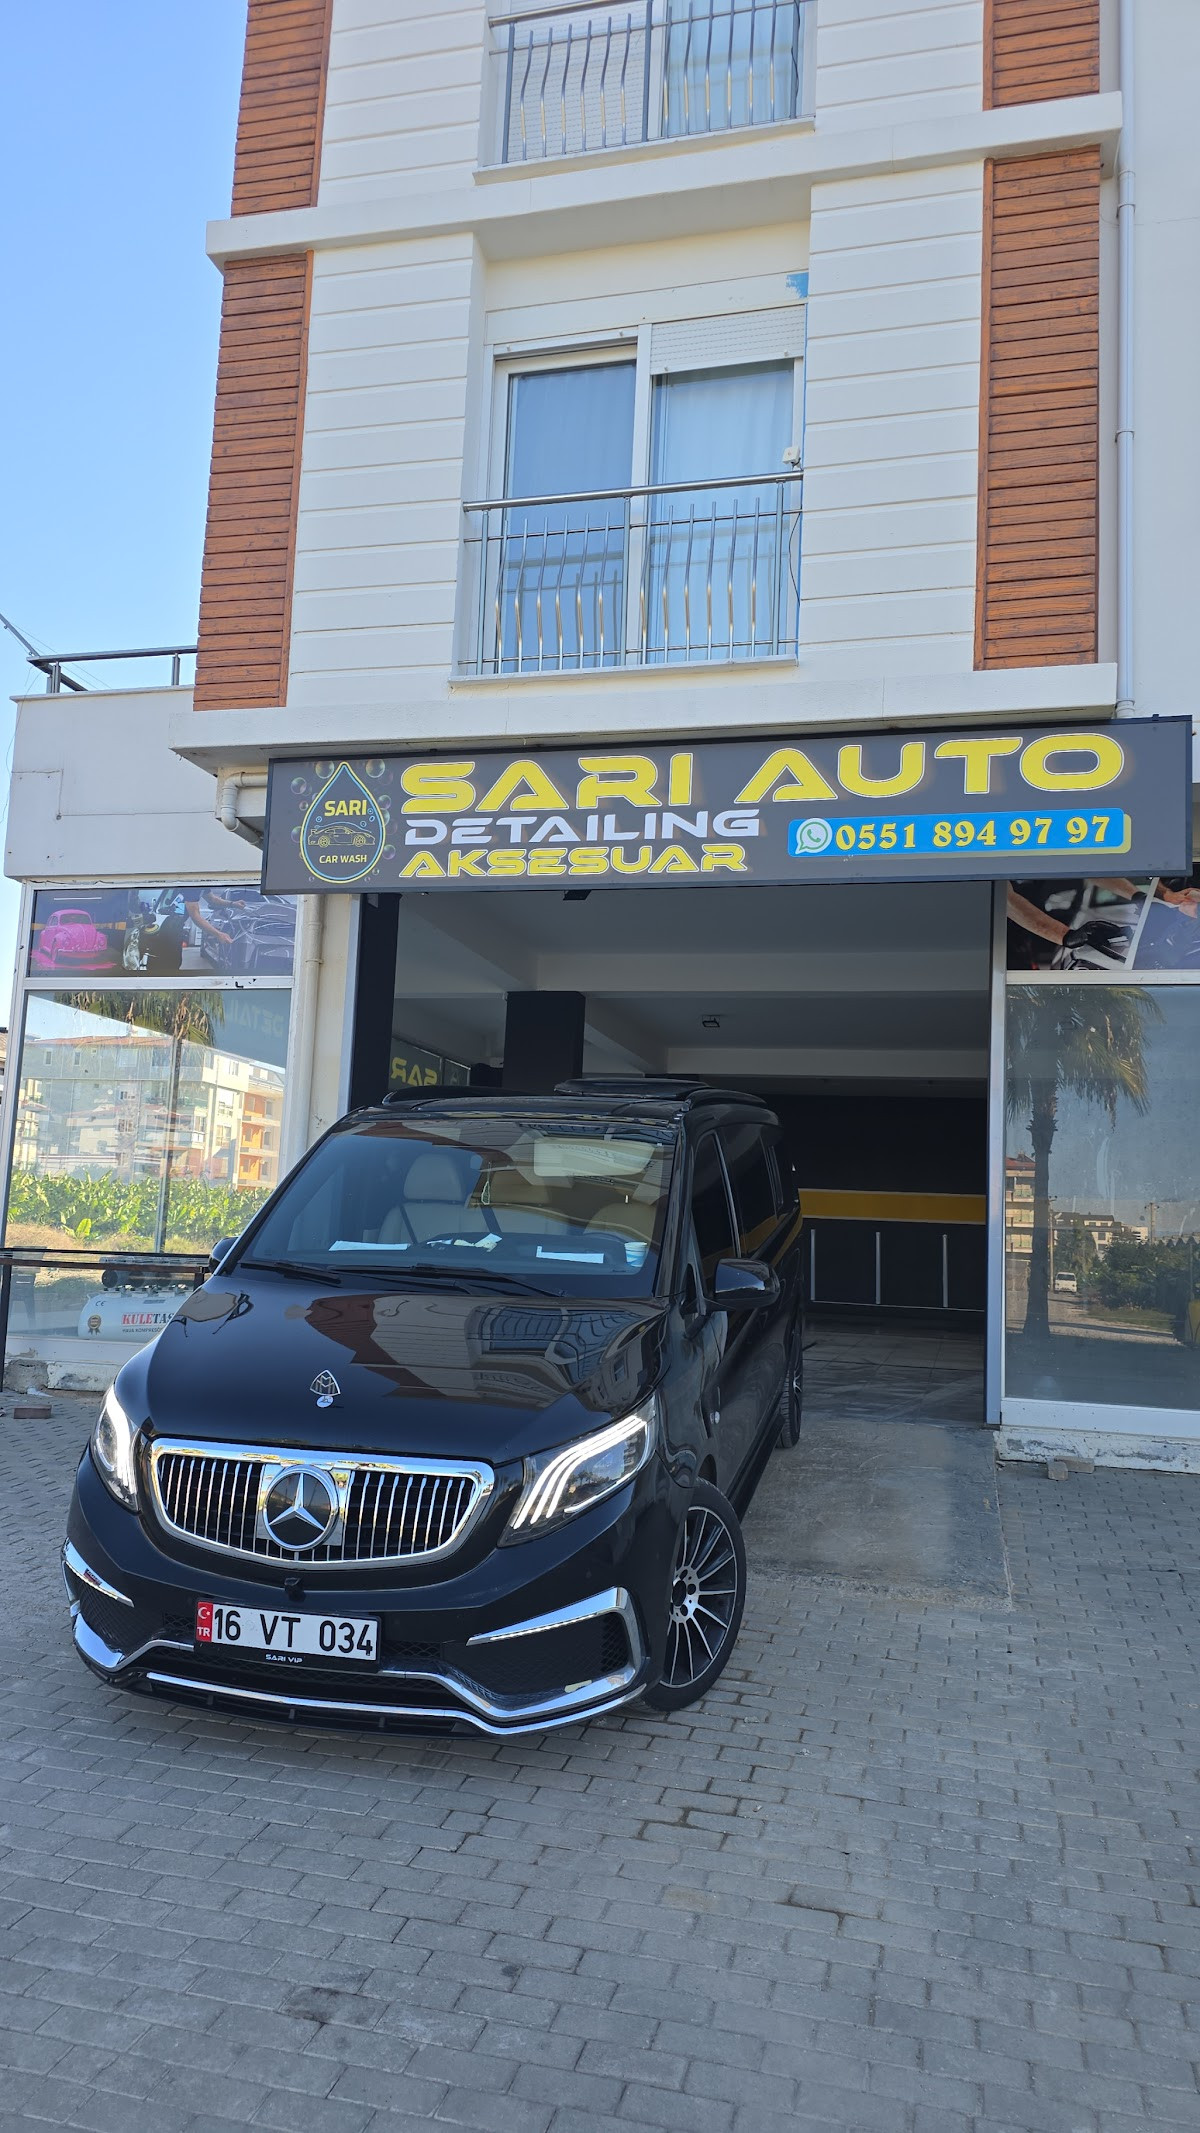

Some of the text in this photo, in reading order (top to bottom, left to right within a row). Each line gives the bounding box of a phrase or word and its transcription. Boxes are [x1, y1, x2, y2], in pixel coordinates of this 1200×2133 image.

[401, 733, 1124, 814] SARI AUTO
[324, 800, 367, 816] SARI
[404, 809, 760, 845] DETAILING
[835, 816, 1110, 851] 0551 894 97 97
[319, 854, 367, 864] CAR WASH
[399, 843, 748, 878] AKSESUAR
[197, 1608, 373, 1656] TR 16 VT 034
[265, 1653, 286, 1662] SARI
